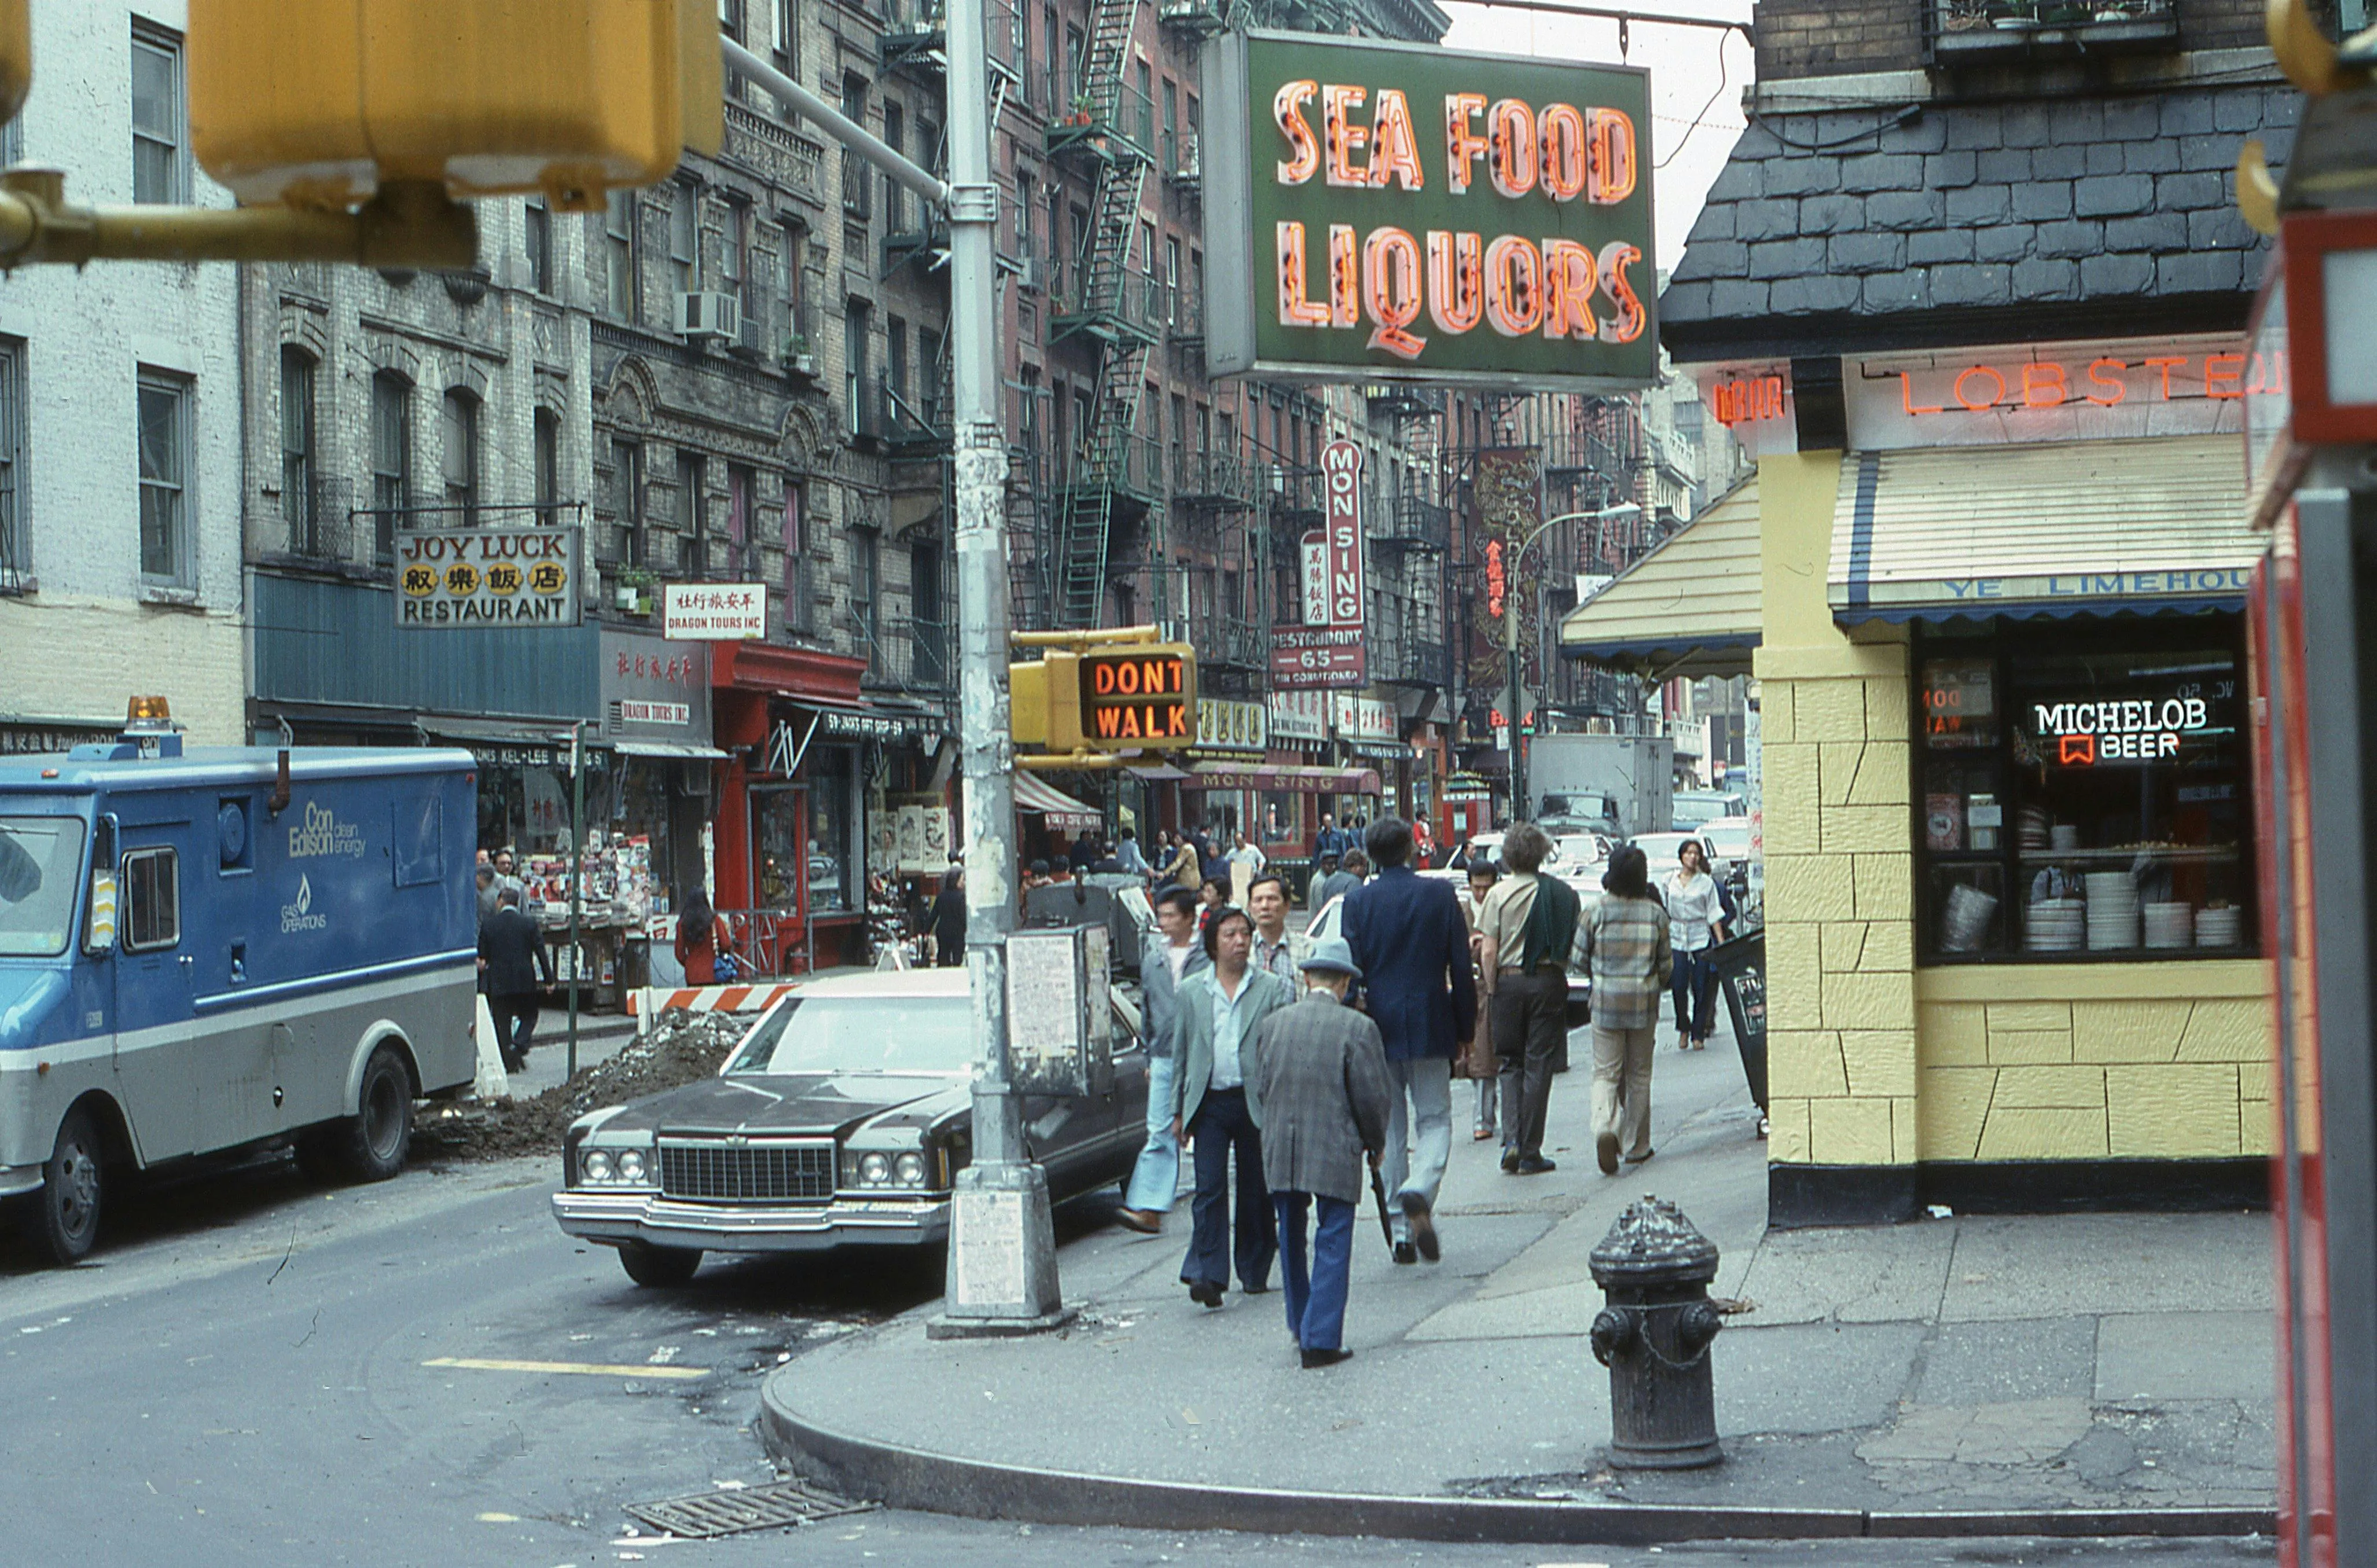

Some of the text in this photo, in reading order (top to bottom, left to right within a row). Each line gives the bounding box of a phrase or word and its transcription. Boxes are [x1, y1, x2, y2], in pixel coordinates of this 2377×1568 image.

[1273, 79, 1637, 206] SEA FOOD
[1276, 219, 1647, 360] LIQUORS
[1900, 353, 2246, 415] LOBSTE
[1731, 379, 1785, 423] BAR
[1329, 447, 1357, 618] MON SING
[401, 534, 567, 560] JOY LUCK
[1946, 569, 2250, 598] YE LIMEHOU
[404, 598, 565, 621] RESTAURANT
[668, 616, 761, 629] DRAGON TOURS INC
[1270, 629, 1362, 648] RESTAURANT
[1301, 649, 1330, 668] 65
[1094, 660, 1183, 694] DONT
[1097, 704, 1186, 739] WALK
[2034, 699, 2207, 735] MICHELOB
[2100, 732, 2179, 758] BEER
[1274, 776, 1333, 790] SING
[306, 800, 333, 833] Con
[333, 821, 359, 839] clean
[289, 827, 334, 858] Edison
[334, 839, 366, 858] energy
[281, 904, 299, 919] GAS
[281, 913, 327, 934] OPERATIONS
